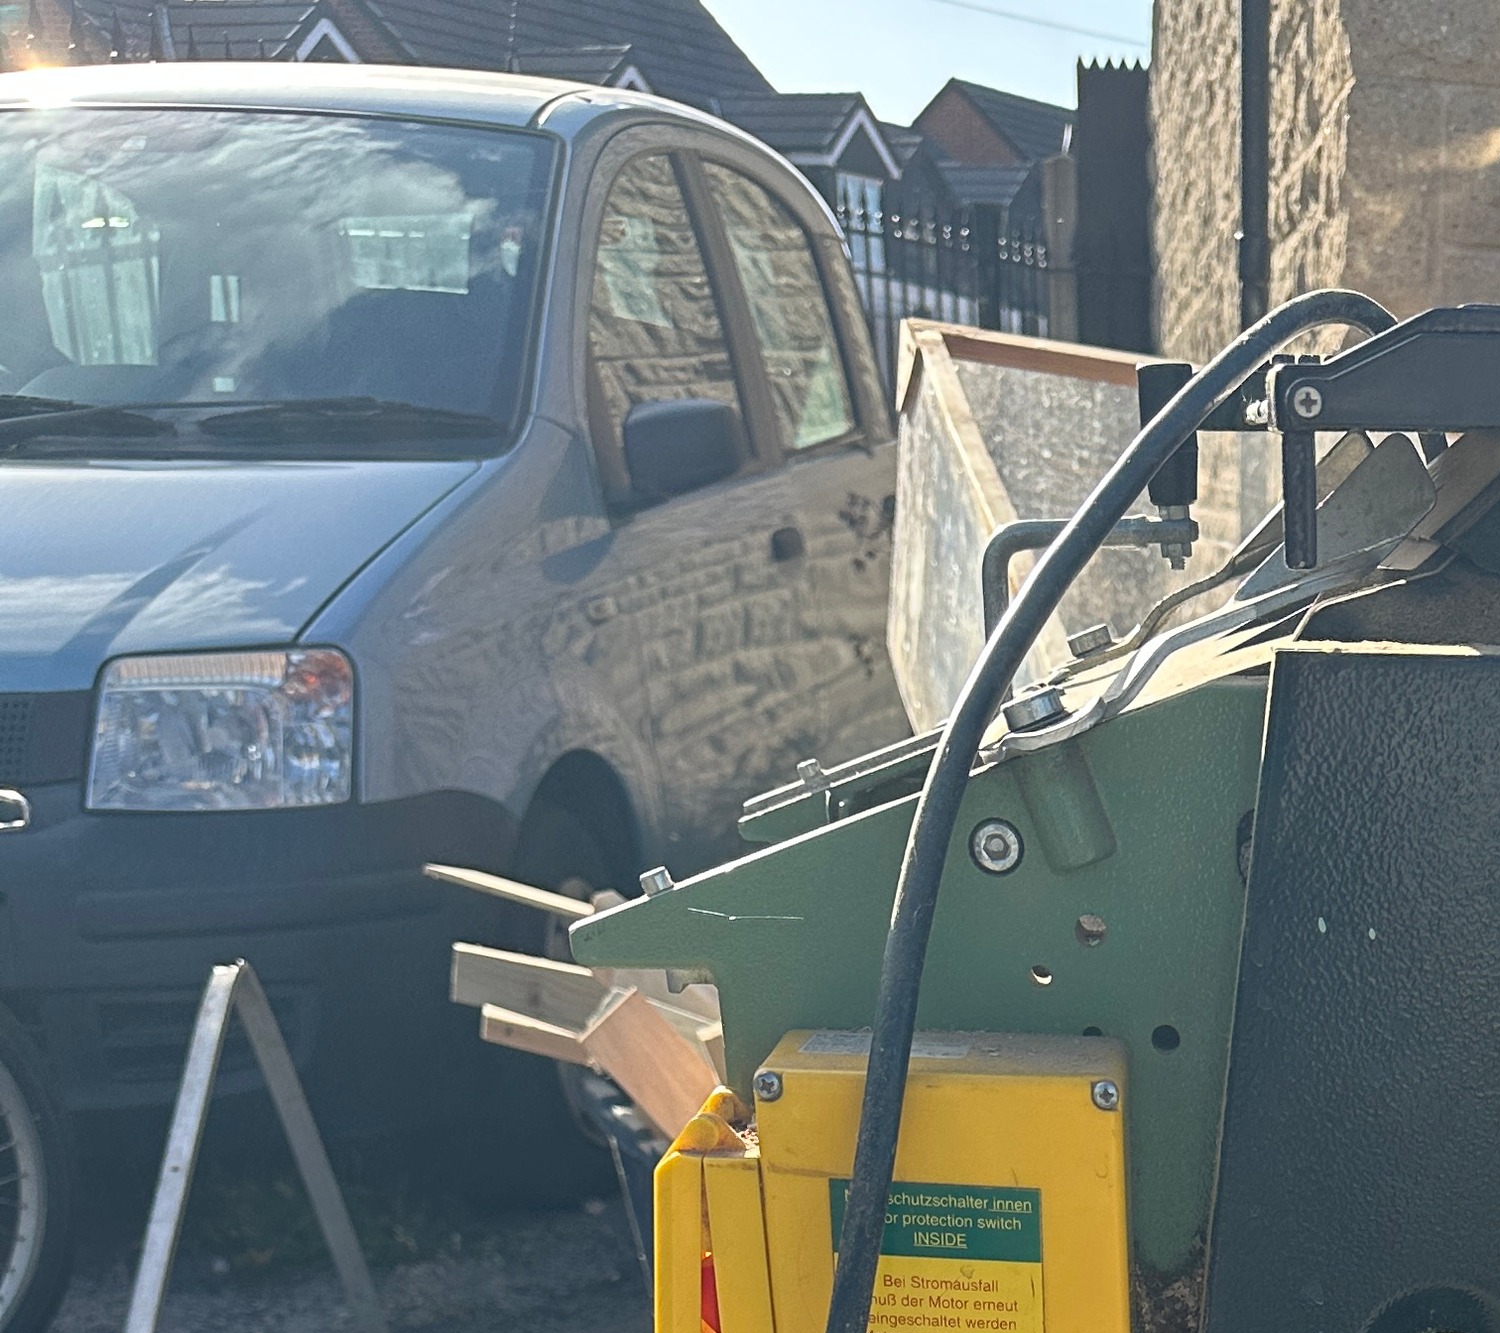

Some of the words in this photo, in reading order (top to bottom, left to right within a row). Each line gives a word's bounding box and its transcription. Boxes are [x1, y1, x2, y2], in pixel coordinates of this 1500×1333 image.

[845, 1188, 988, 1210] schutzschalter
[992, 1198, 1032, 1211] innen
[903, 1213, 973, 1229] protection
[977, 1217, 1021, 1230] switch
[913, 1232, 967, 1247] INSIDE
[884, 1275, 905, 1288] Bei
[911, 1276, 999, 1292] Stromausfall
[901, 1295, 923, 1308] der
[929, 1296, 968, 1309] Motor
[973, 1300, 1018, 1312] erneut
[965, 1317, 1017, 1330] werden
